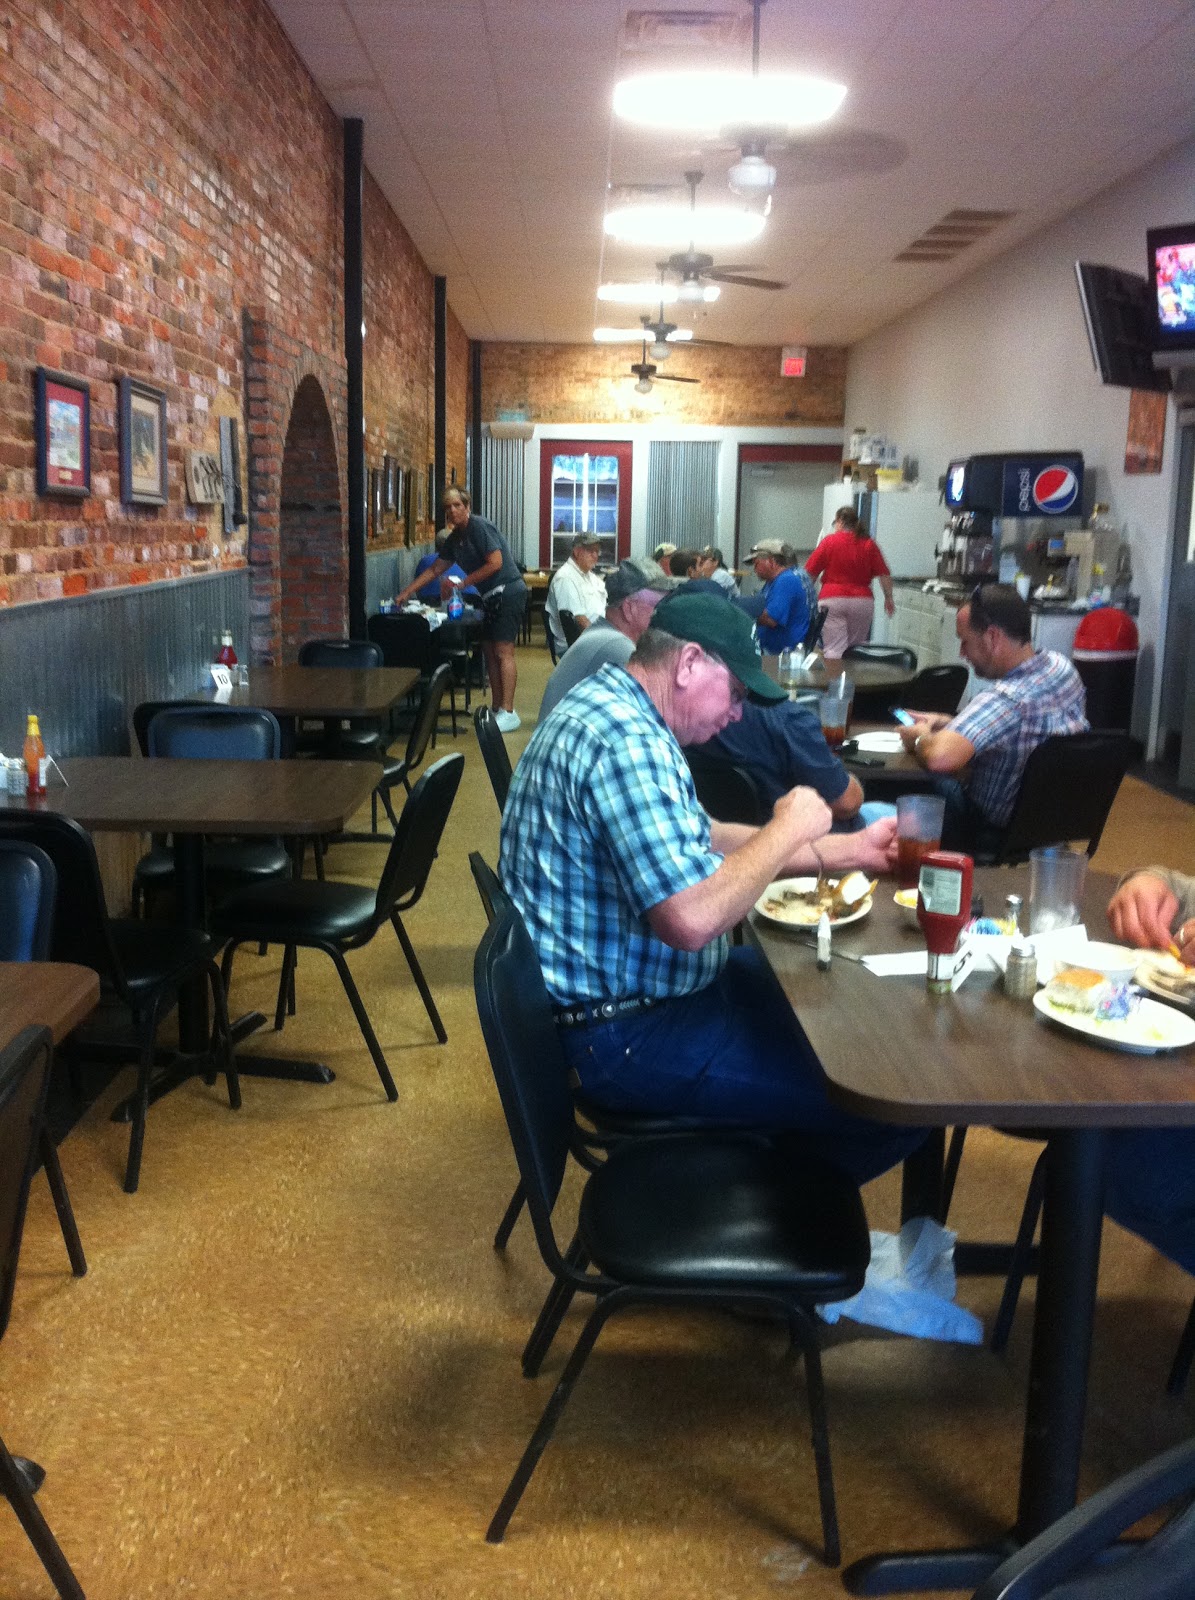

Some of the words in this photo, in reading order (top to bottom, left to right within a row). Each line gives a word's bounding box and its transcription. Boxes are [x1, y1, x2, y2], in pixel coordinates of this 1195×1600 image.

[1018, 468, 1031, 512] pepsi
[217, 674, 229, 685] 10
[953, 949, 973, 975] 5
